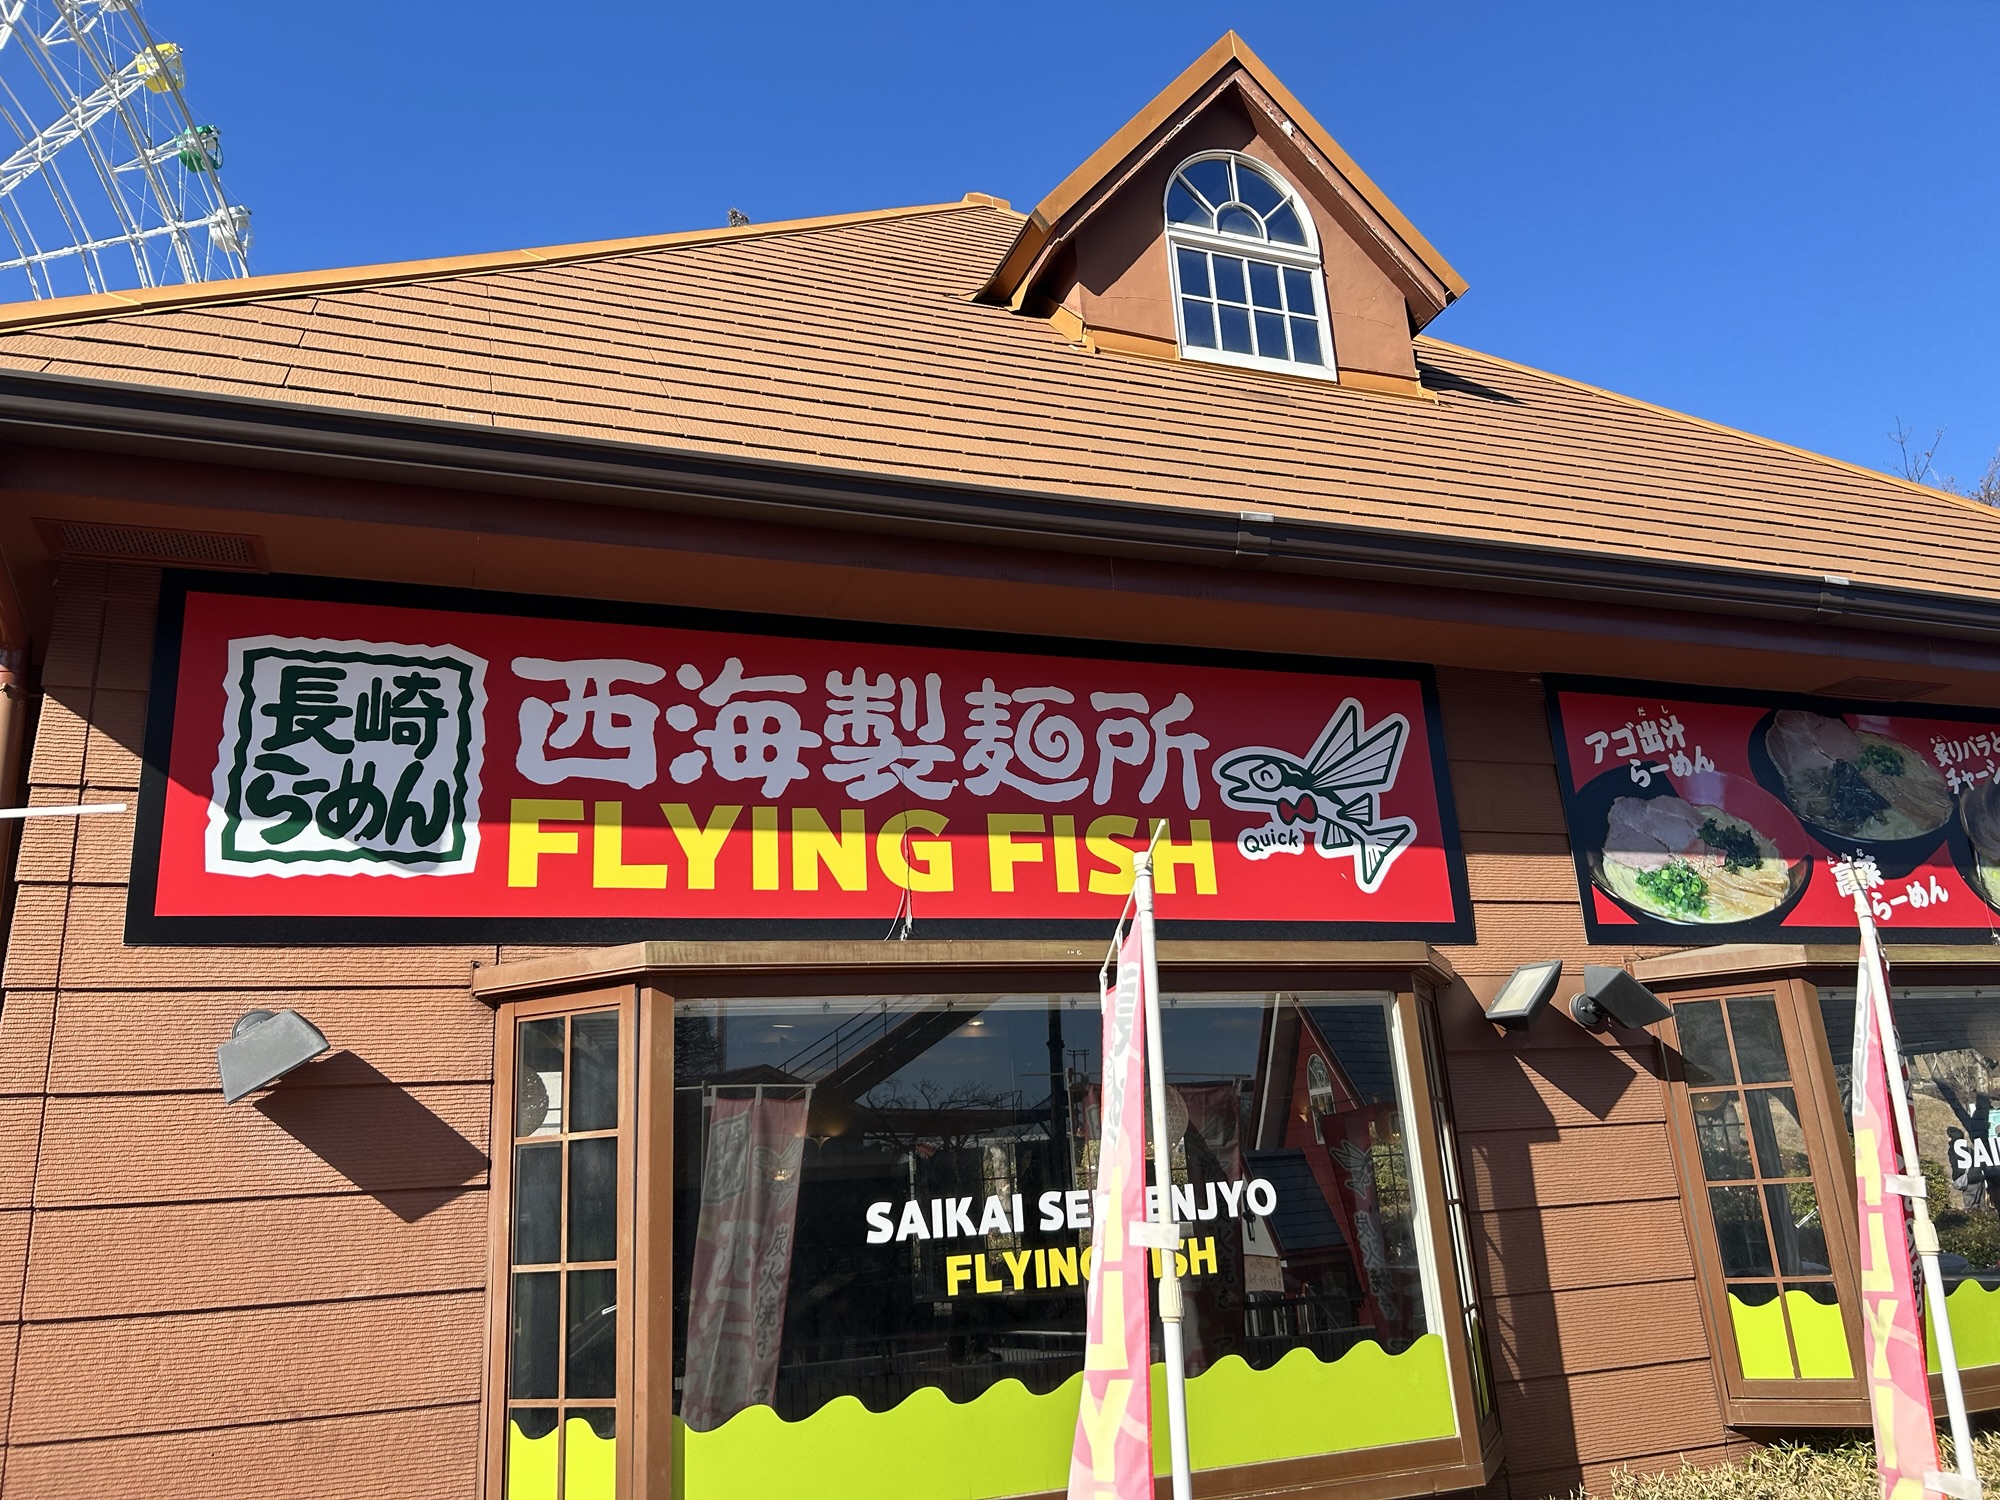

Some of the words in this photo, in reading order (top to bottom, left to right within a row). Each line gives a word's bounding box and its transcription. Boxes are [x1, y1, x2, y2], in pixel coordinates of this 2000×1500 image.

[261, 665, 449, 759] 長崎
[511, 657, 1210, 811] 西海製麺所
[1584, 714, 1686, 765] アゴ出汁
[1629, 745, 1715, 788] らーめん
[245, 757, 450, 848] らーめん
[508, 798, 954, 892] FLYING
[987, 813, 1218, 895] FISH
[1243, 828, 1299, 853] Quick
[1870, 874, 1949, 921] らーめん
[865, 1194, 1025, 1244] SAIKAI
